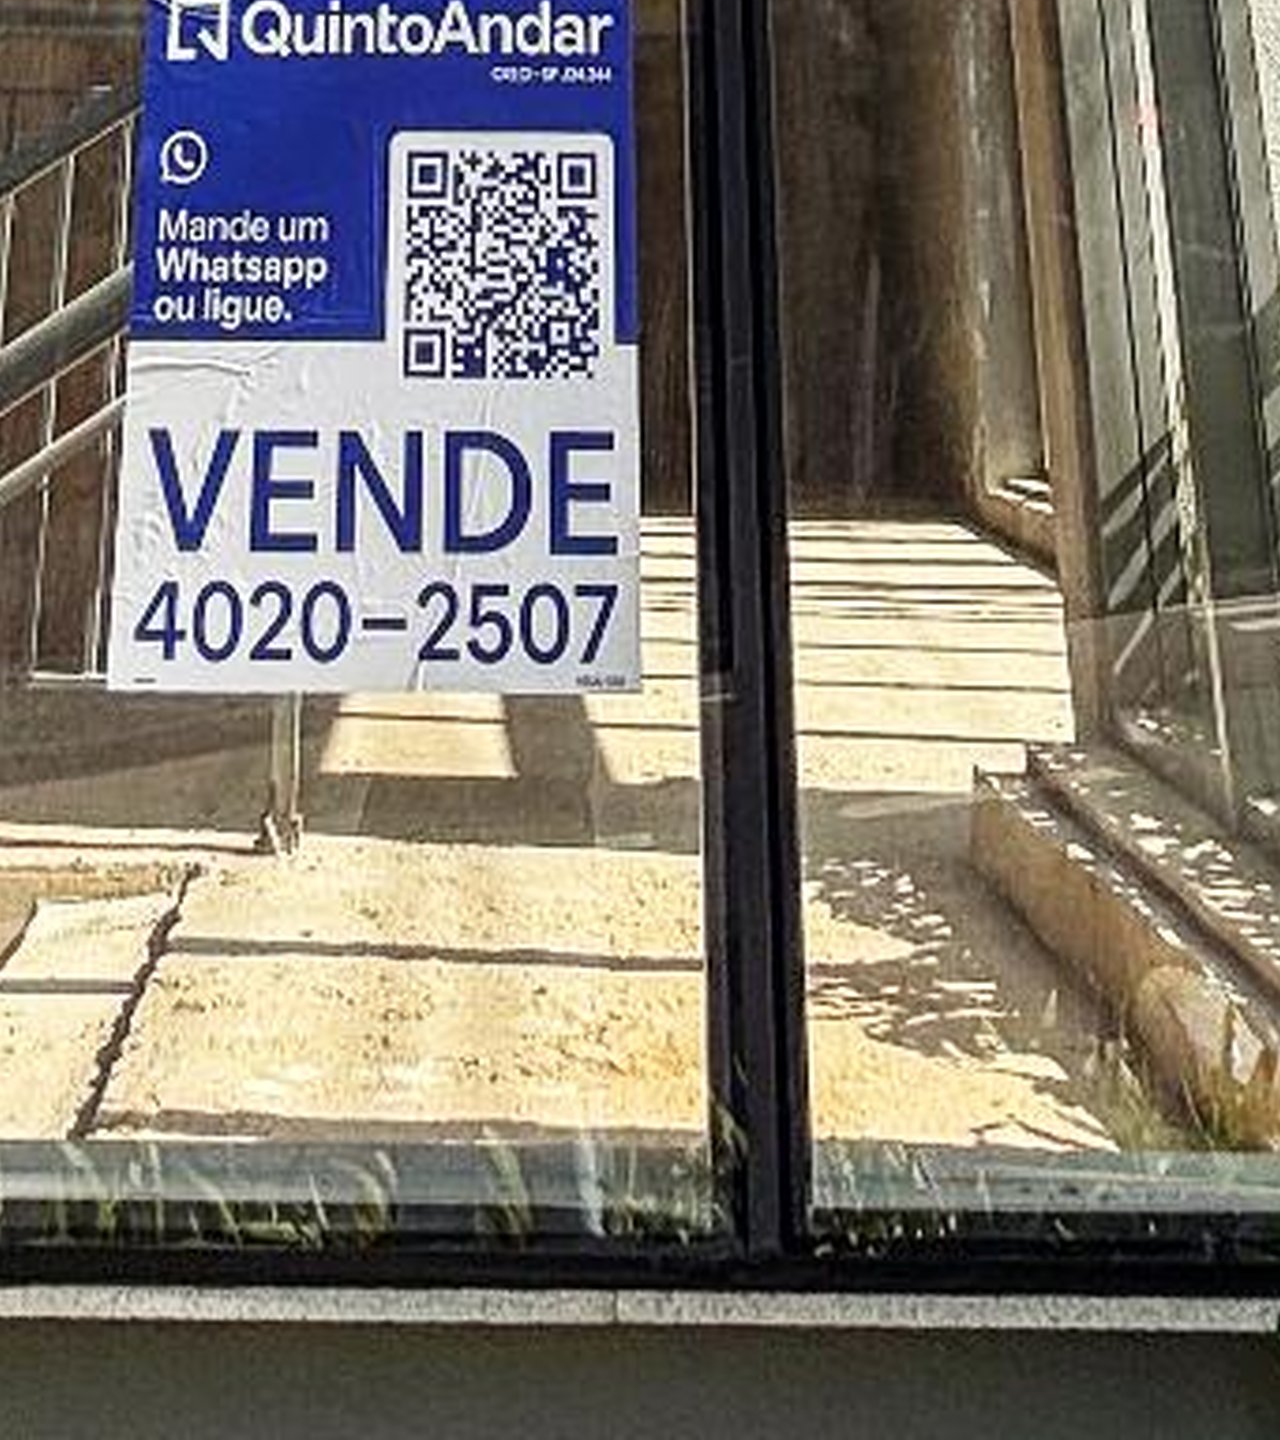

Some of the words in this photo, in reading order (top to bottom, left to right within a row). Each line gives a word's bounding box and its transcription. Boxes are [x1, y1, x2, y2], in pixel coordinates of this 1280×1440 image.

[241, 0, 614, 57] QuintoAndar
[159, 209, 269, 242] Mande
[278, 217, 329, 242] um
[156, 247, 328, 289] Whatsapp
[153, 295, 195, 321] ou
[204, 287, 292, 330] ligue.
[149, 429, 619, 556] VENDE
[134, 580, 619, 665] 4020-2507
